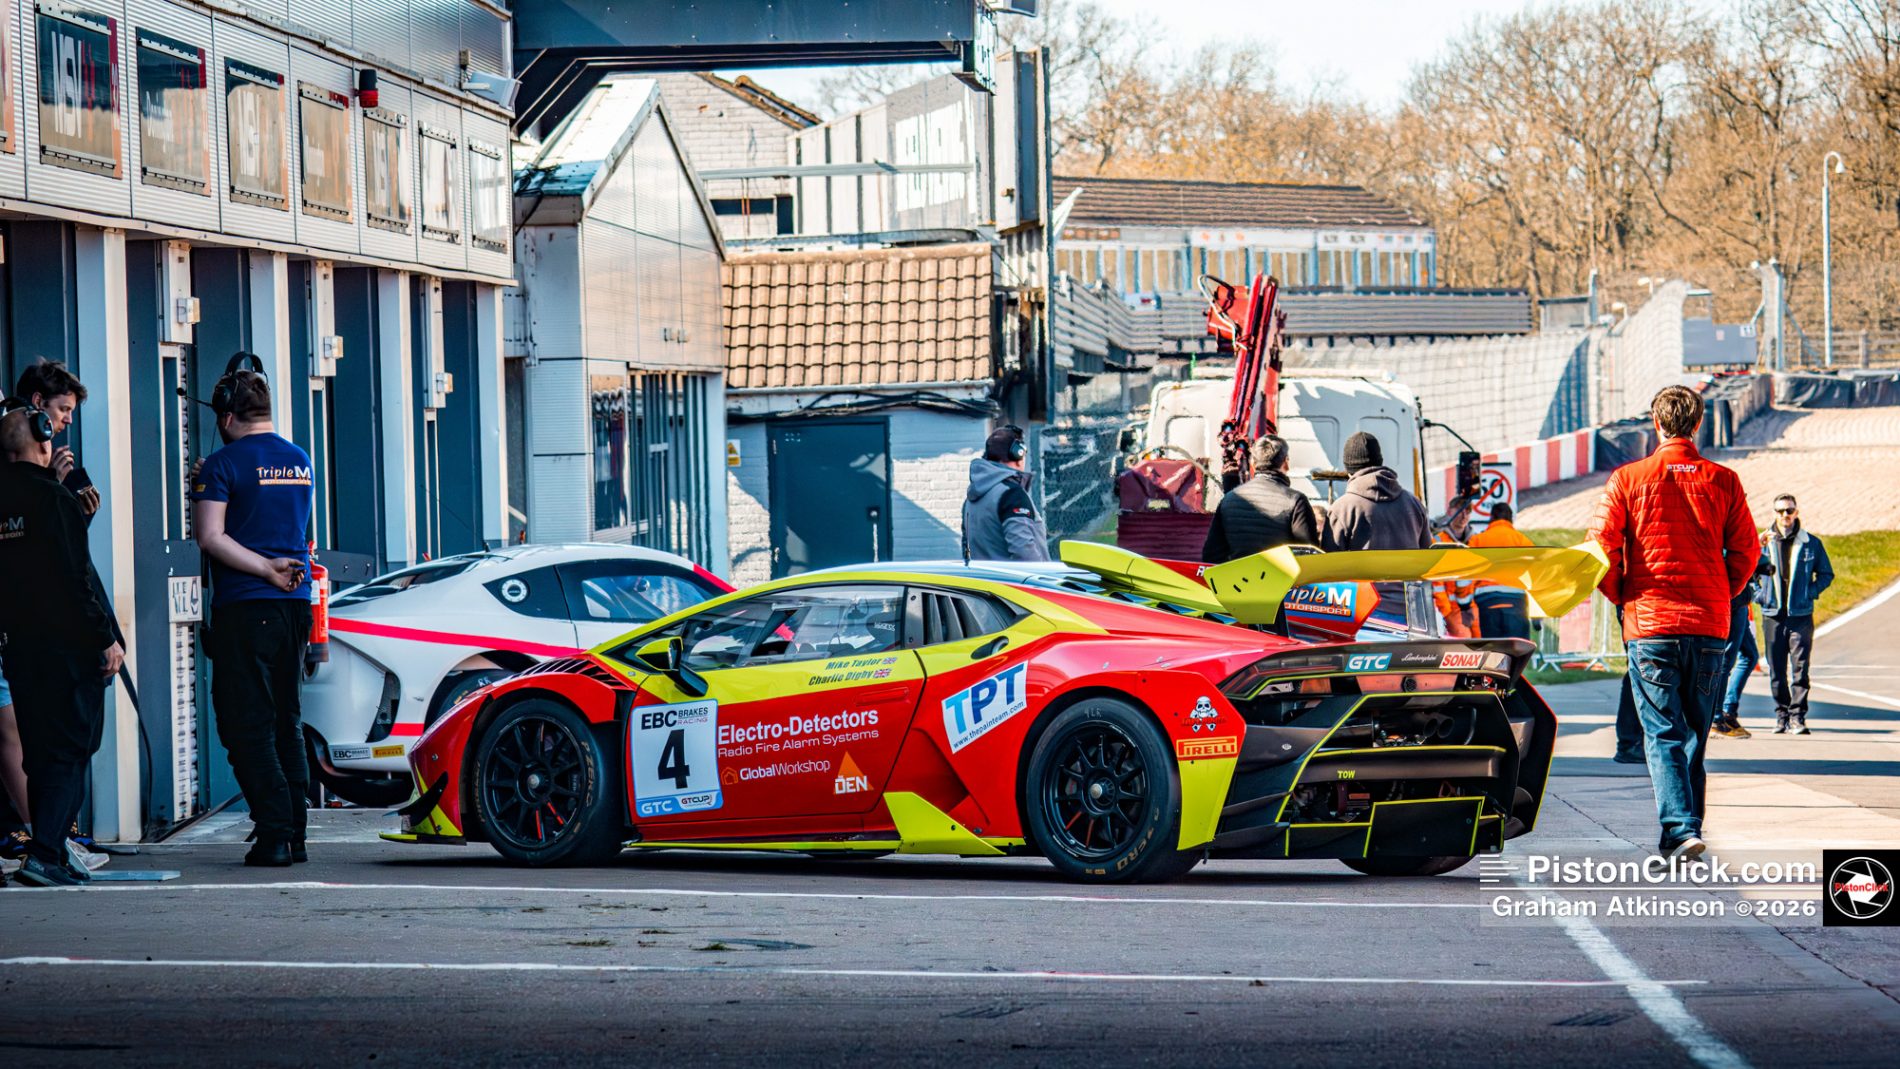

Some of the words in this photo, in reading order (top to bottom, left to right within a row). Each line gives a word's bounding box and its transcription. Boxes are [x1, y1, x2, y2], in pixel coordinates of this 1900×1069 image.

[1284, 602, 1350, 616] OTORSPORT
[825, 661, 850, 670] Mike
[851, 659, 881, 667] Taylor
[1349, 655, 1389, 670] GTC
[1442, 653, 1480, 667] SONAX
[808, 674, 844, 686] Charlie
[845, 670, 873, 681] Digby
[945, 663, 1025, 734] TPT
[641, 710, 677, 730] EBC
[678, 707, 708, 718] BRAKES
[677, 717, 708, 725] RACING
[718, 709, 879, 745] Electro-Detectors
[718, 746, 753, 758] Radio
[755, 741, 781, 754] Fire
[782, 736, 820, 750] Alarm
[822, 729, 879, 747] Systems
[1178, 738, 1235, 757] PIRELLI
[333, 750, 352, 758] EBC
[657, 729, 690, 789] 4
[739, 760, 831, 780] GlobalWorkshop
[1337, 770, 1356, 779] TOW
[641, 800, 672, 814] GTC
[681, 795, 710, 804] GTCUP
